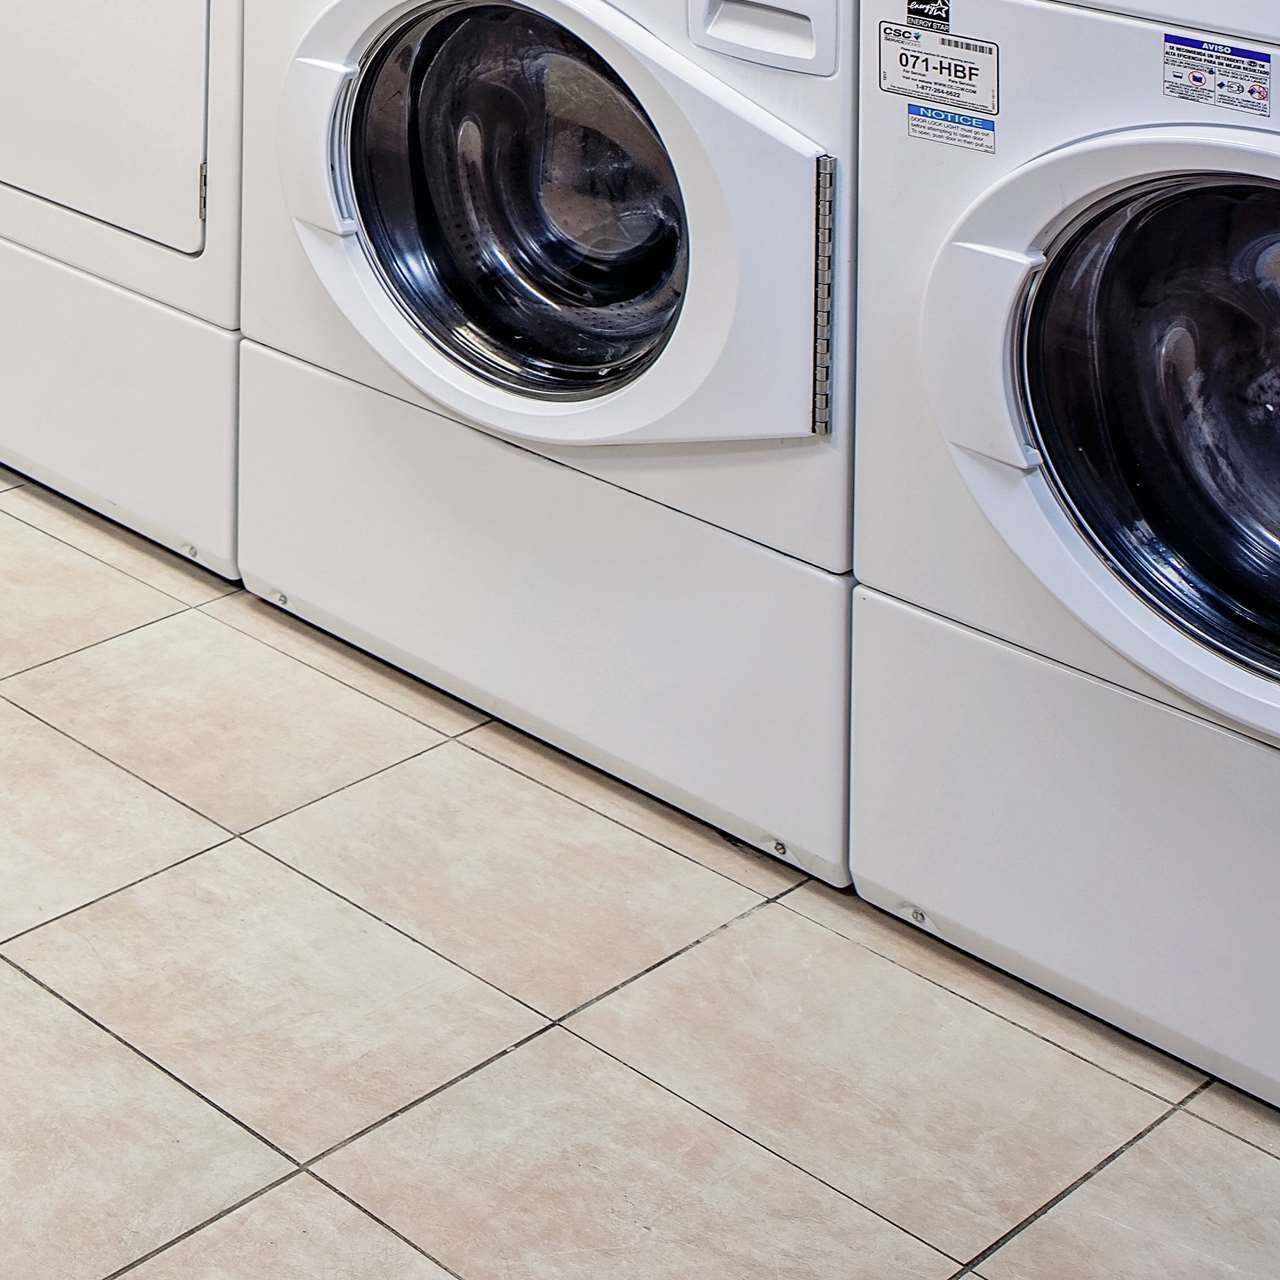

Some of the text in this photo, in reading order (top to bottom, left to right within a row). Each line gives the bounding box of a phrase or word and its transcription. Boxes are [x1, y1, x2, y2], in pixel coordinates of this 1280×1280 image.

[907, 18, 931, 28] ENERGY
[883, 27, 912, 39] CSC
[1202, 43, 1231, 53] AVISO
[899, 53, 979, 81] 071-HBF
[920, 108, 983, 127] NOTICE
